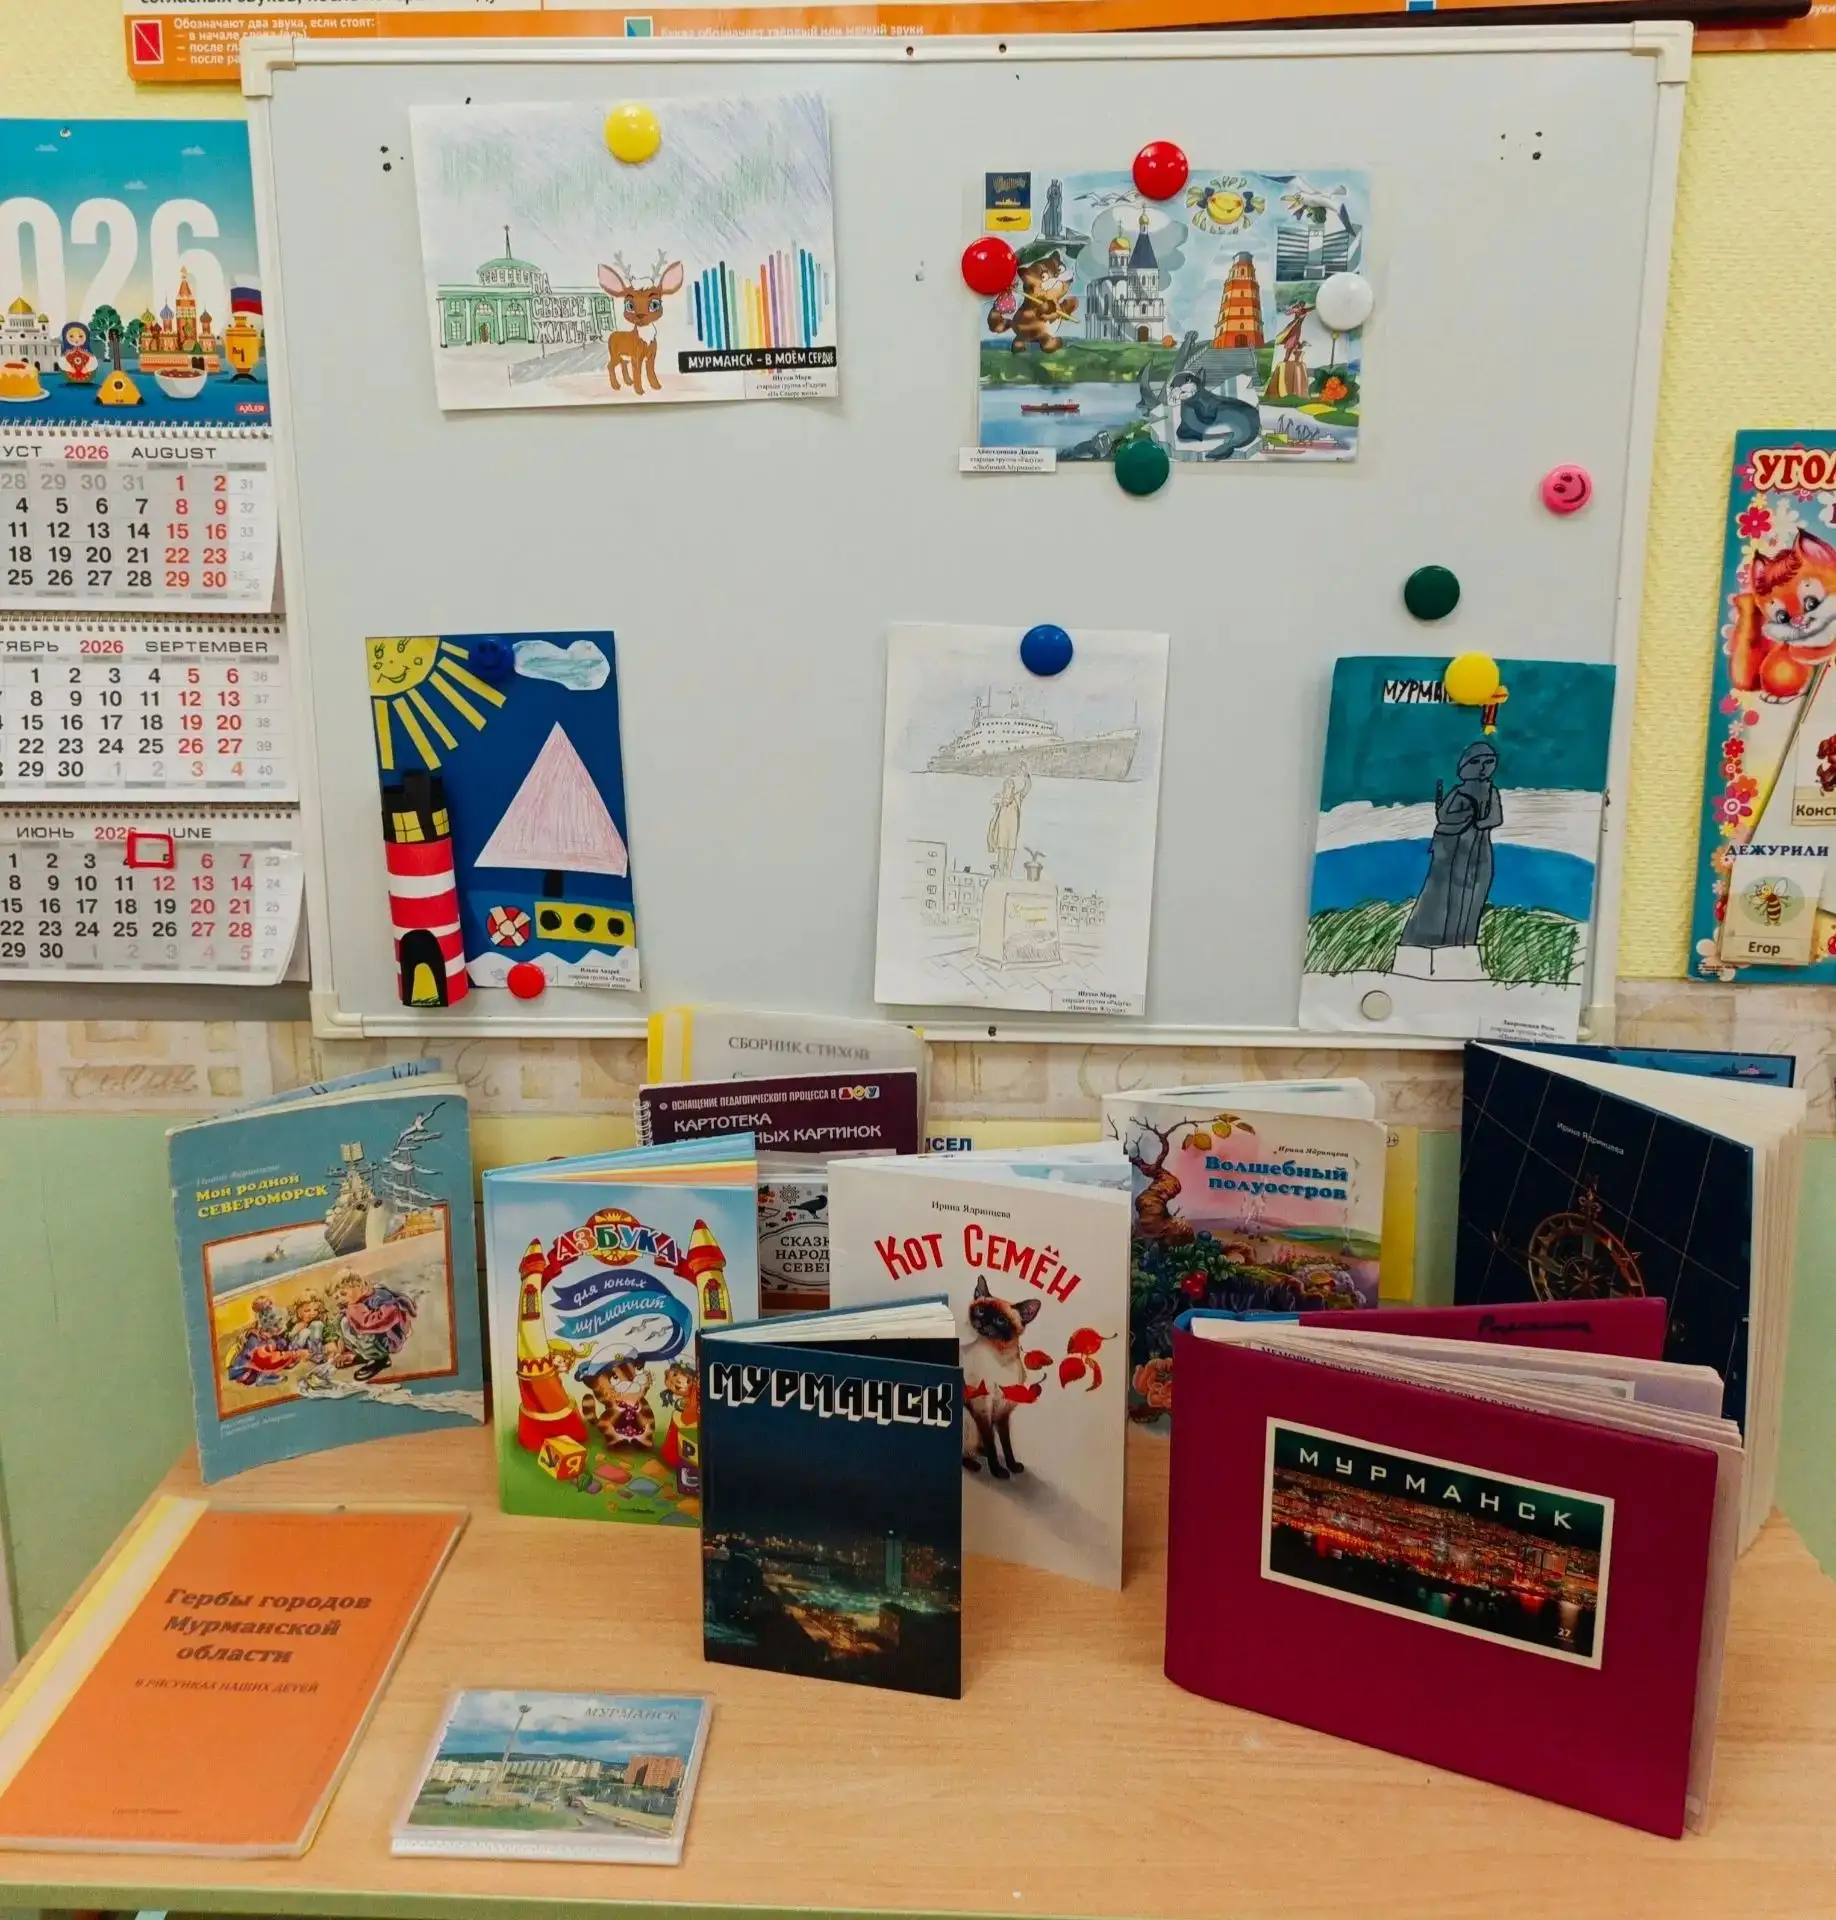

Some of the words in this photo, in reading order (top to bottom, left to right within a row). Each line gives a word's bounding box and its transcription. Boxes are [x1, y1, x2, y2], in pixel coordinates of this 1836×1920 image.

[174, 17, 244, 29] Обозначают
[248, 19, 268, 30] два
[272, 19, 307, 31] звука,
[310, 19, 337, 28] если
[340, 18, 376, 28] стоят:
[200, 31, 240, 40] начале
[190, 44, 223, 52] после
[191, 55, 224, 64] после
[688, 354, 753, 369] МУРМАНСК
[765, 354, 772, 366] В
[775, 351, 806, 365] МОЁМ
[64, 445, 109, 460] 2026
[132, 447, 216, 459] AUGUST
[1, 474, 27, 490] 28
[41, 474, 66, 490] 29
[81, 474, 106, 490] 30
[123, 474, 144, 491] 31
[176, 476, 184, 491] 1
[214, 475, 226, 491] 2
[16, 498, 28, 513] 4
[57, 498, 68, 513] 5
[96, 498, 108, 514] 6
[136, 499, 148, 514] 7
[176, 499, 188, 514] 8
[215, 499, 226, 515] 9
[9, 522, 27, 537] 11
[48, 522, 70, 538] 12
[88, 522, 109, 538] 13
[128, 523, 150, 538] 14
[167, 523, 188, 539] 15
[206, 524, 226, 540] 16
[9, 546, 31, 562] 18
[49, 546, 71, 562] 19
[86, 547, 111, 563] 20
[127, 547, 148, 563] 21
[165, 548, 189, 563] 22
[203, 548, 226, 564] 23
[8, 569, 33, 585] 25
[48, 570, 73, 586] 26
[88, 570, 112, 586] 27
[127, 571, 151, 586] 28
[166, 571, 189, 587] 29
[203, 571, 226, 587] 30
[80, 640, 124, 654] 2026
[146, 641, 267, 652] SEPTEMBER
[31, 691, 42, 706] 8
[70, 691, 82, 706] 9
[100, 691, 122, 706] 10
[141, 691, 158, 706] 11
[179, 691, 201, 706] 12
[218, 691, 240, 707] 13
[1383, 680, 1450, 703] МУРМА
[17, 827, 73, 838] ИЮНЬ
[1725, 844, 1829, 857] ДЕЖУРИЛИ
[1, 898, 22, 913] 15
[40, 898, 60, 913] 16
[77, 899, 97, 913] 17
[115, 899, 137, 914] 18
[154, 899, 176, 914] 19
[191, 899, 215, 914] 20
[230, 899, 249, 914] 21
[1748, 942, 1780, 956] Егор
[729, 1036, 802, 1054] СБОРНИК
[805, 1043, 870, 1060] СТИХОВ
[671, 1097, 718, 1112] ОСНАЩЕНИЕ
[720, 1092, 788, 1108] ПЕДАГОГИЧЕСКОГО
[789, 1090, 829, 1102] ПРОЦЕССА
[674, 1113, 772, 1133] КАРТОТЕКА
[794, 1124, 882, 1143] КАРТИНОК
[1205, 1155, 1348, 1182] Волшебный
[196, 1186, 231, 1202] Мой
[236, 1172, 300, 1196] родной
[1208, 1177, 1348, 1200] полуостров
[198, 1184, 328, 1218] СЕВЕРОМОРСК
[932, 1200, 960, 1213] Ирина
[963, 1204, 1011, 1219] Ядринцева
[556, 1224, 679, 1266] АЗБУКА
[776, 1250, 829, 1261] НАРОД
[573, 1285, 599, 1306] для
[604, 1278, 648, 1289] юных
[572, 1295, 667, 1335] мурманчат
[709, 1362, 953, 1427] МУРМАНСК
[1299, 1447, 1572, 1530] МУРМАНСК
[164, 1588, 253, 1609] Гербы
[258, 1594, 374, 1612] городов
[164, 1615, 342, 1636] Мурманской
[1557, 1628, 1572, 1638] 27
[176, 1644, 294, 1663] области
[144, 1679, 216, 1690] РИСУНКАХ
[219, 1681, 270, 1692] НАШИХ
[273, 1681, 319, 1694] ДЕТЕЙ
[584, 1706, 680, 1721] МУРМАНСК
